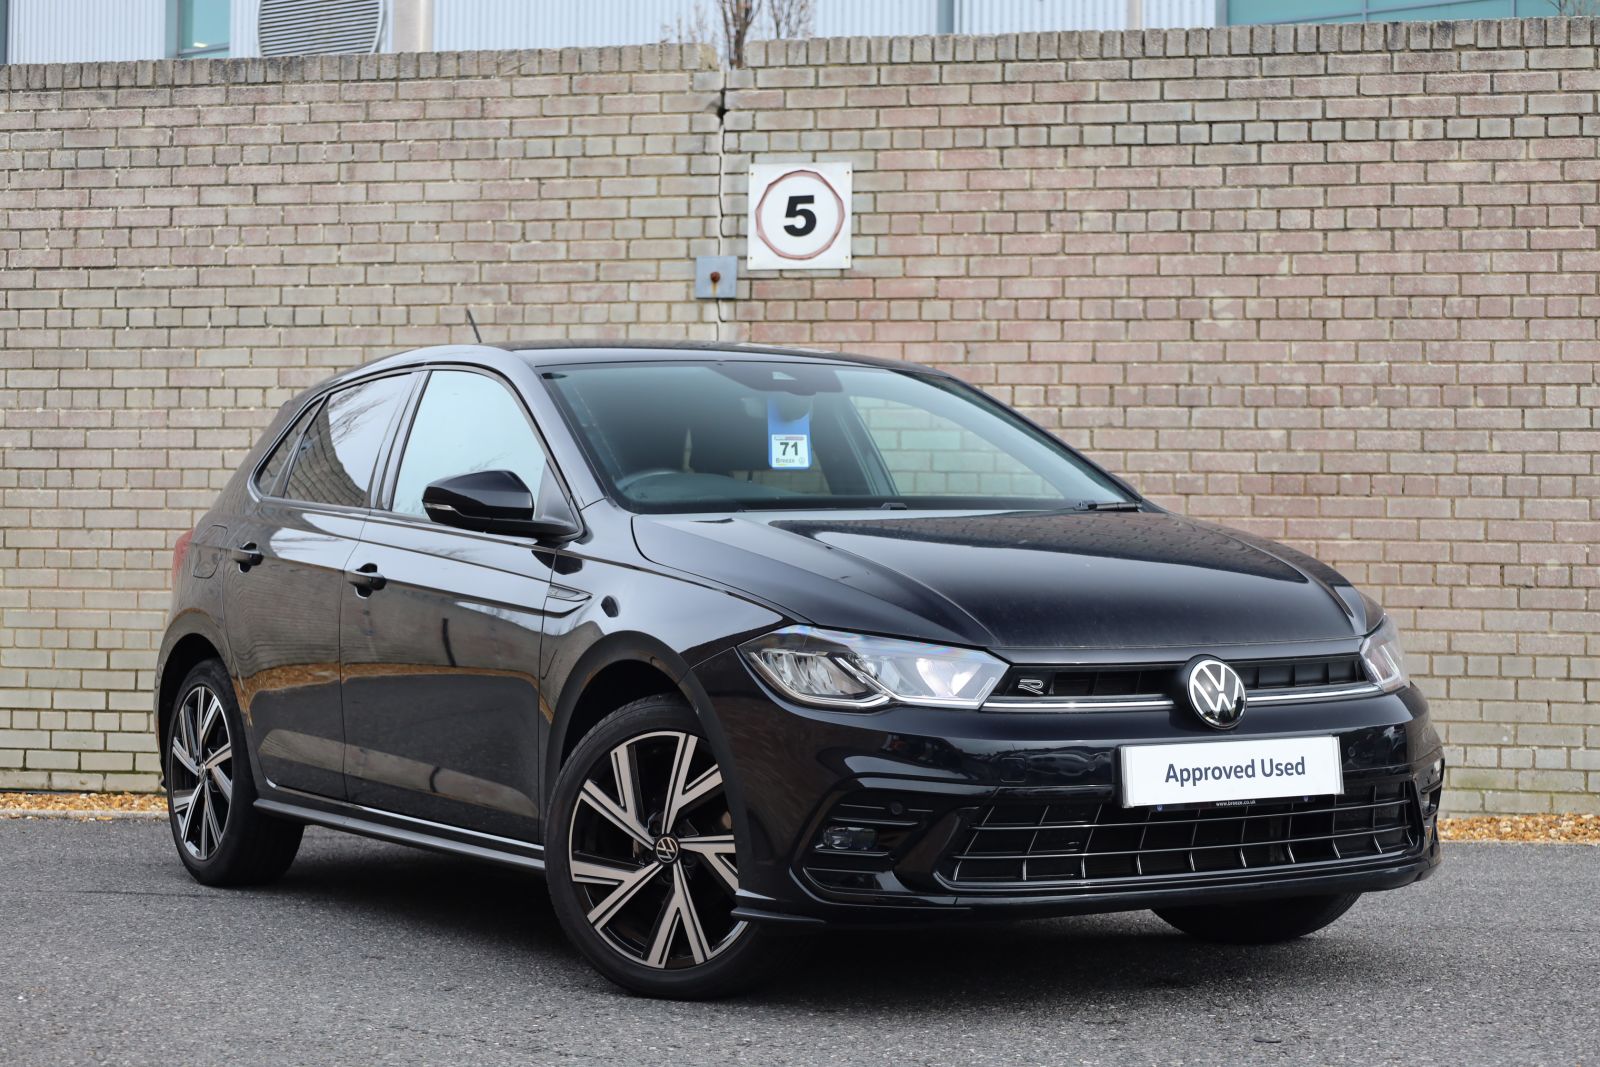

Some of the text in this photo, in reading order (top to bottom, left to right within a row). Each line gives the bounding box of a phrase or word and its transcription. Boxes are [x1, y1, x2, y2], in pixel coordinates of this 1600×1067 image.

[784, 194, 816, 237] 5
[780, 442, 798, 456] 71
[1165, 756, 1306, 787] Approved Used
[1215, 799, 1257, 807] www.breeze.co.uk
